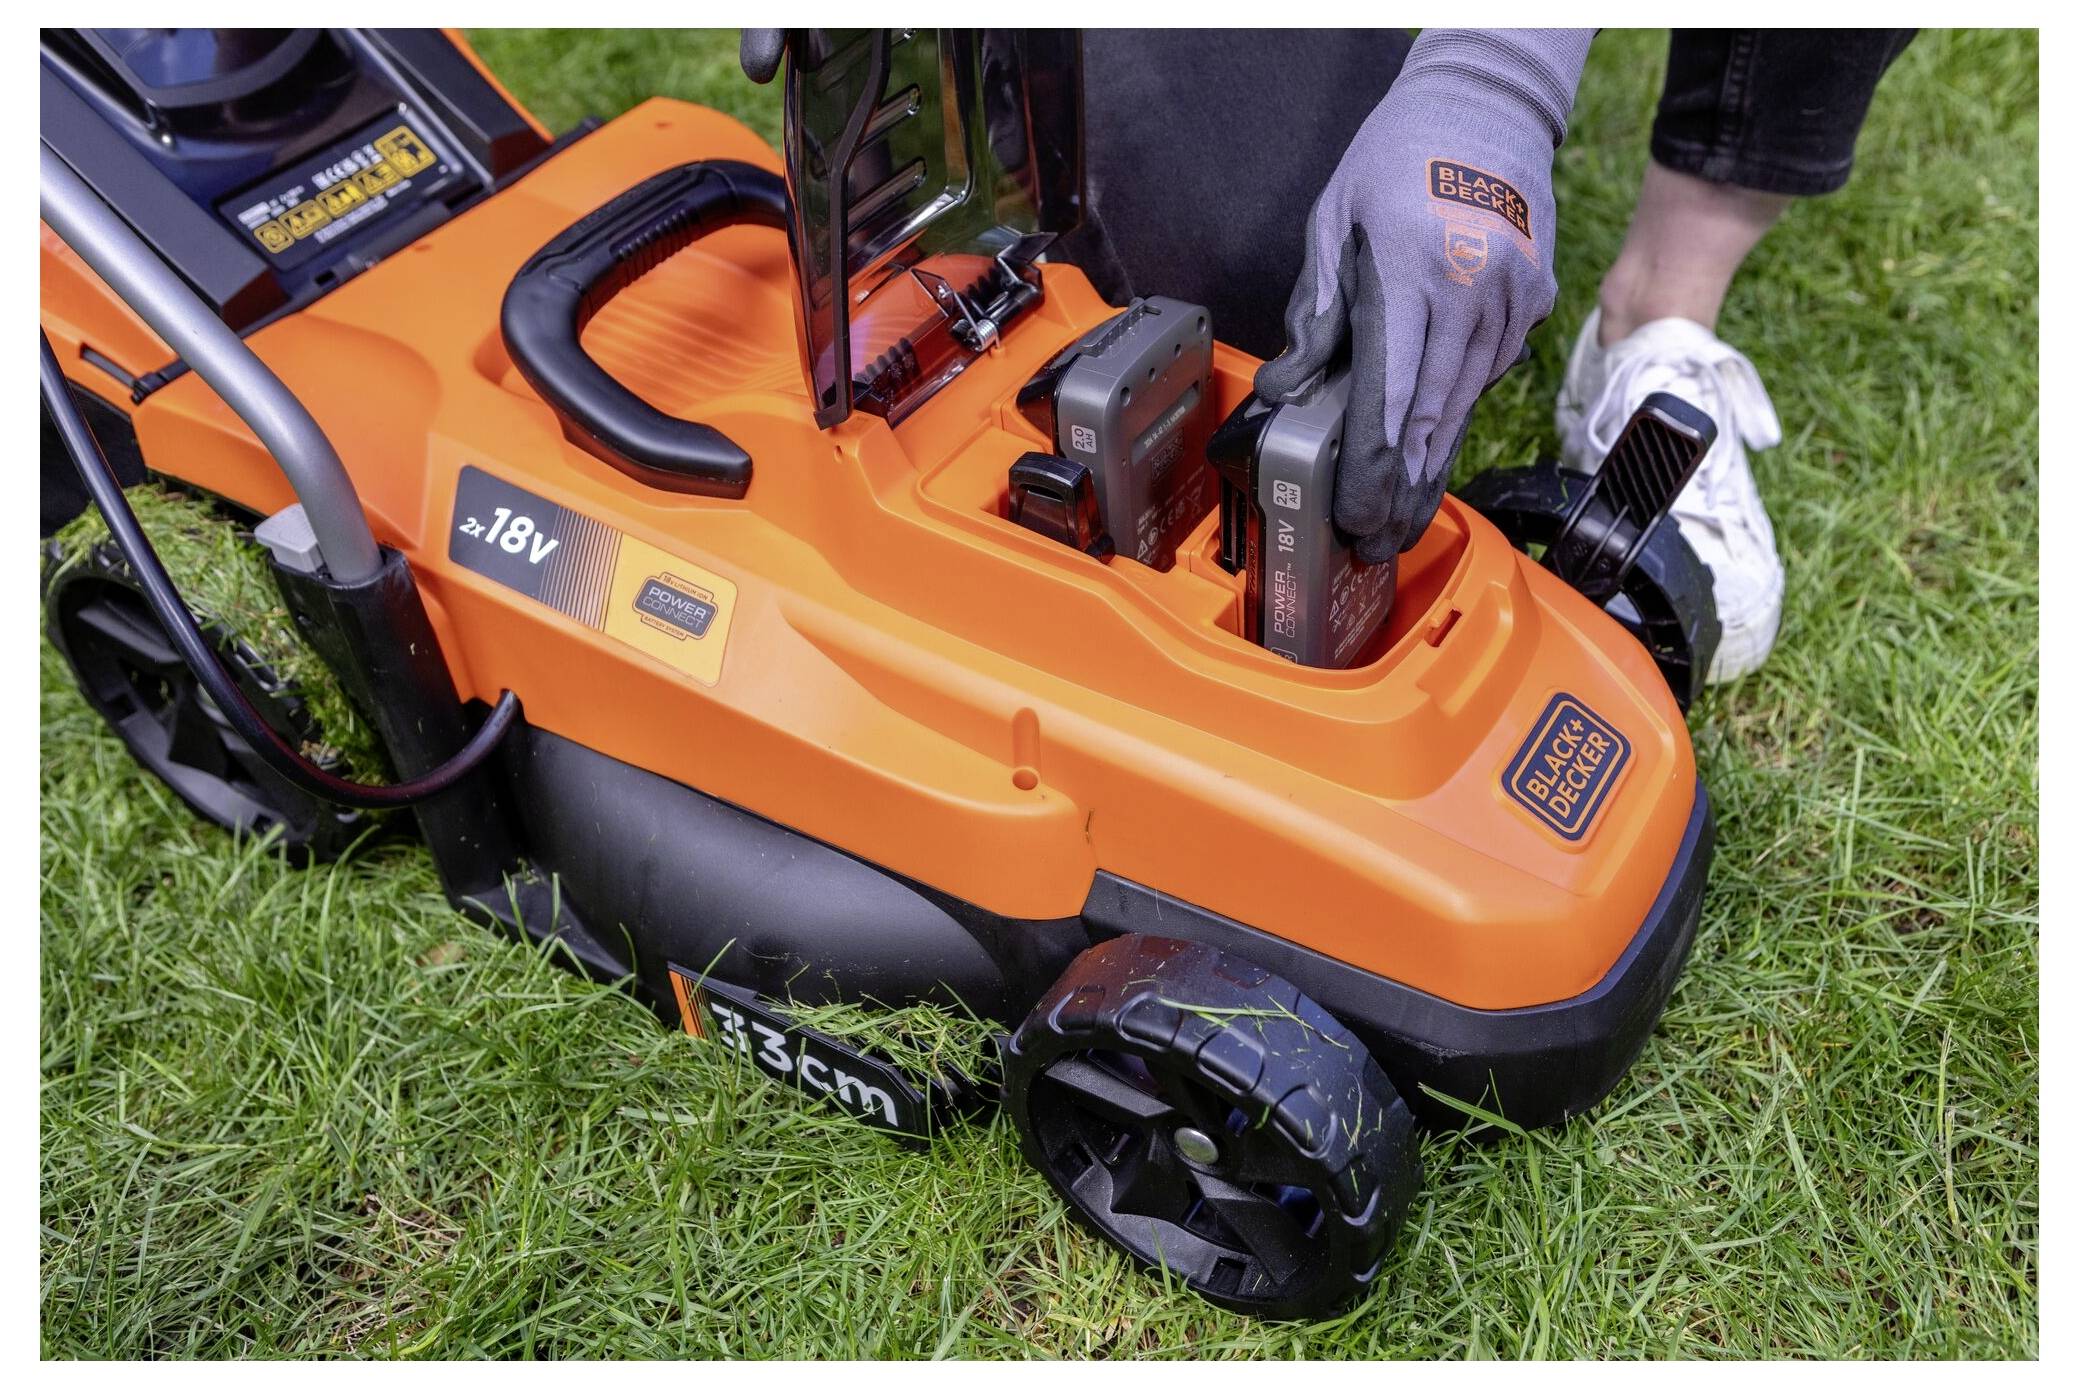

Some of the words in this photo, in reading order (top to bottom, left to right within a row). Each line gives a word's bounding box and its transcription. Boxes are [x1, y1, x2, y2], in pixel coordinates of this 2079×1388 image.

[1439, 167, 1524, 213] BLACK+
[1439, 182, 1525, 229] DECKER
[1074, 428, 1084, 449] 2.0
[1276, 482, 1288, 505] 2.0
[1288, 490, 1298, 504] AH
[1278, 519, 1295, 552] 18V
[642, 596, 704, 628] CONNECT
[648, 586, 707, 619] POWER
[1274, 570, 1286, 634] POWER
[1526, 719, 1585, 801] BLACK+
[1548, 731, 1611, 819] DECKER
